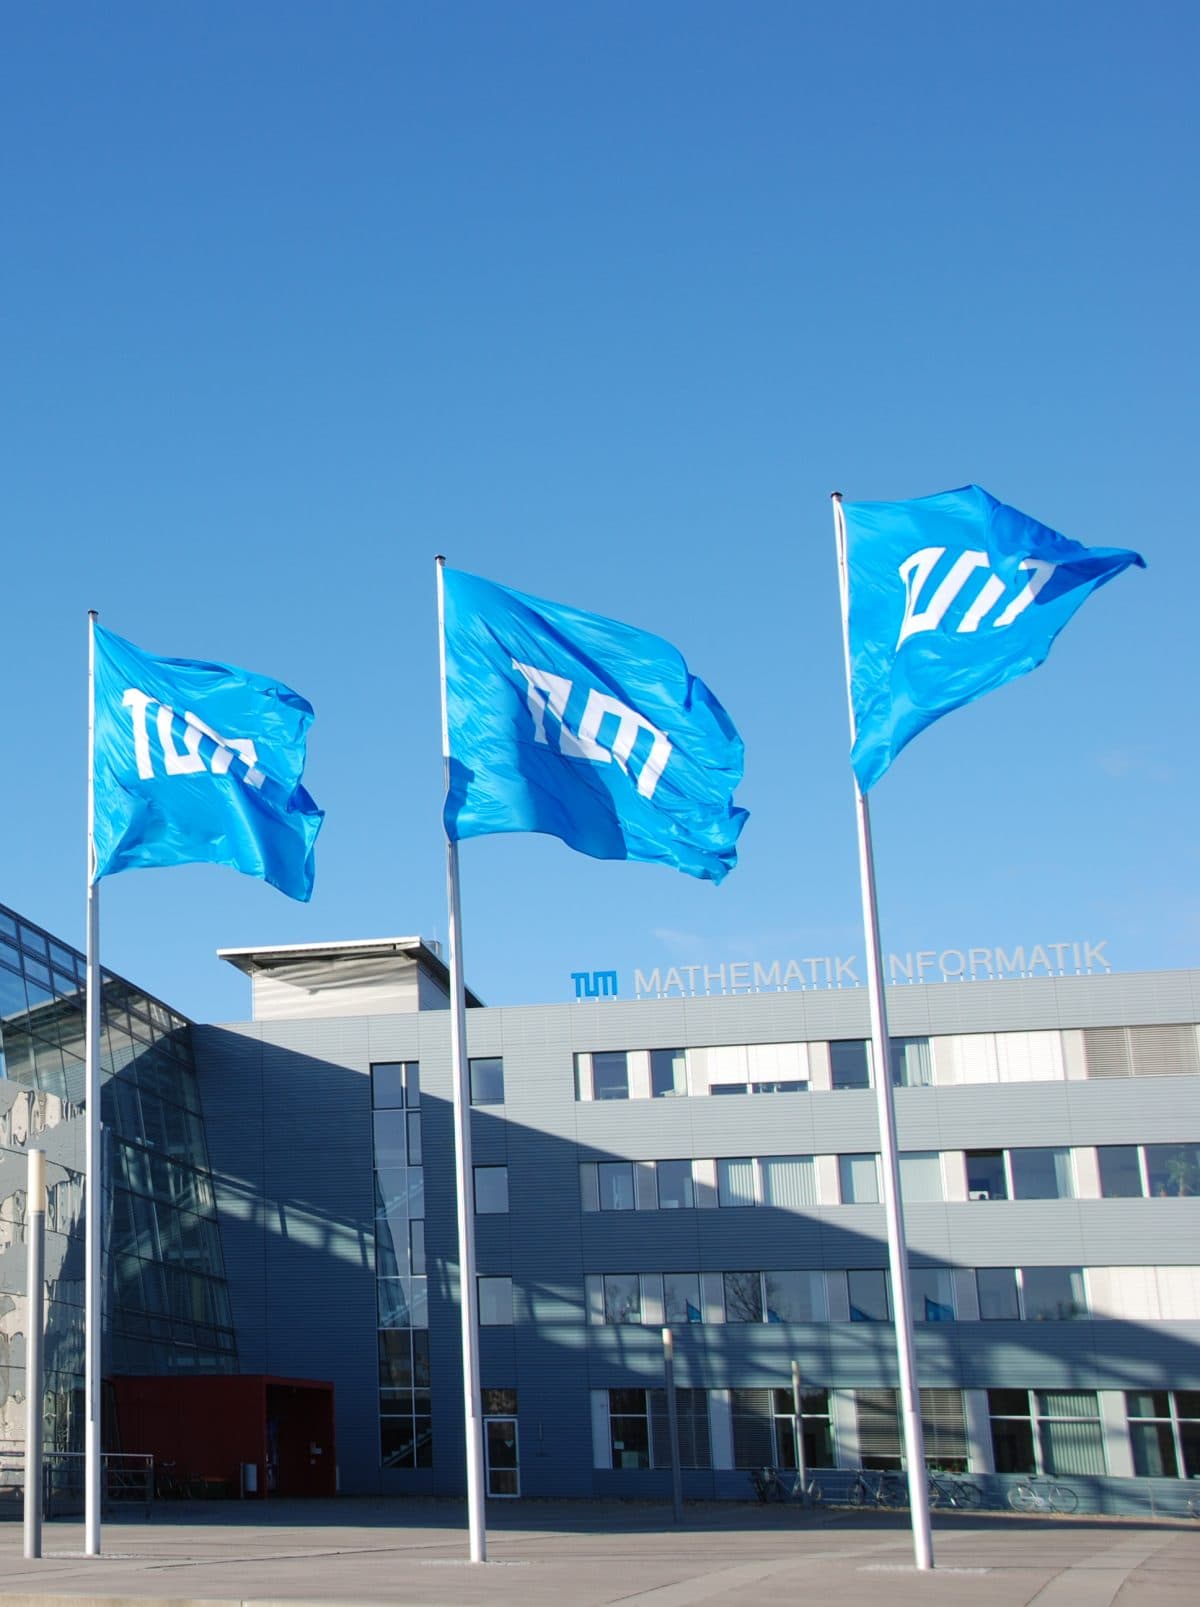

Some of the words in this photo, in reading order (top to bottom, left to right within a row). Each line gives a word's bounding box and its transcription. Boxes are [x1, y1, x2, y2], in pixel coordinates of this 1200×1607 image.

[570, 970, 618, 998] TUM
[633, 954, 860, 994] MATHEMATIK
[888, 938, 1112, 979] NFORMATIK
